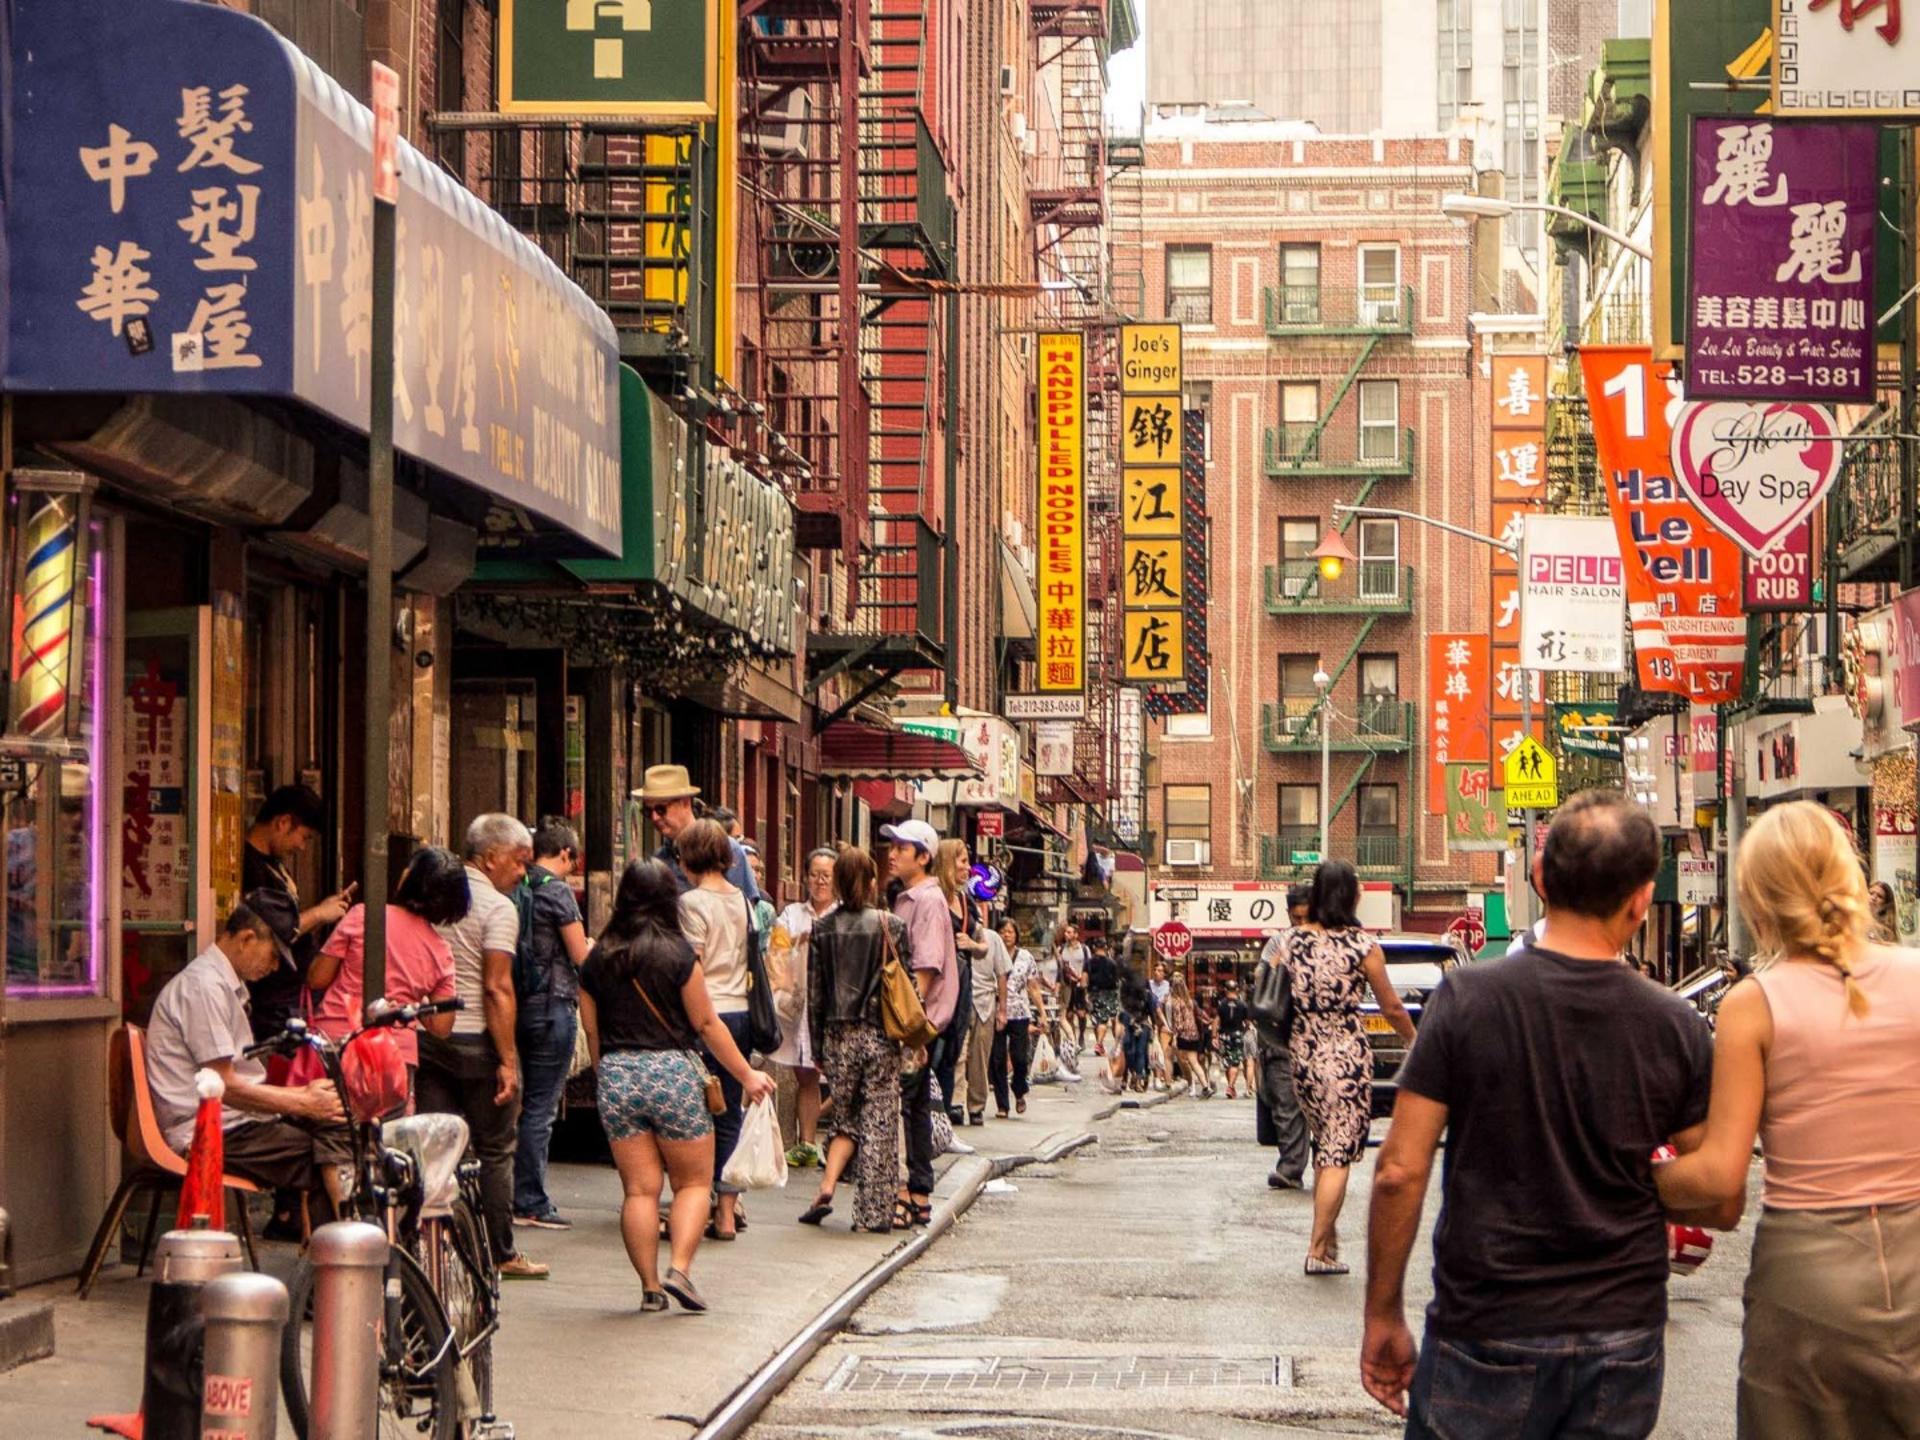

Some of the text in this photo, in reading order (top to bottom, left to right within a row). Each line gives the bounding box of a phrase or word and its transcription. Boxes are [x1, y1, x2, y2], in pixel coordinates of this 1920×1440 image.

[77, 124, 159, 337] 中華
[177, 84, 263, 368] 髮型屋
[1132, 333, 1170, 352] Joe's
[1699, 336, 1862, 361] Lee Lee Beauty & Hair Salon
[1125, 359, 1177, 383] Ginger
[533, 404, 580, 509] BEAUTY
[1700, 473, 1812, 505] Day Spa
[1127, 402, 1180, 672] 錦江飯店
[1630, 510, 1692, 544] Le
[1530, 556, 1620, 584] PELL
[1748, 553, 1808, 575] FOOT
[1528, 585, 1621, 598] HAIR SALON
[1756, 578, 1800, 600] RUB
[1511, 789, 1551, 801] AHEAD
[1156, 931, 1190, 945] STOP
[206, 1382, 249, 1410] ABOVE
